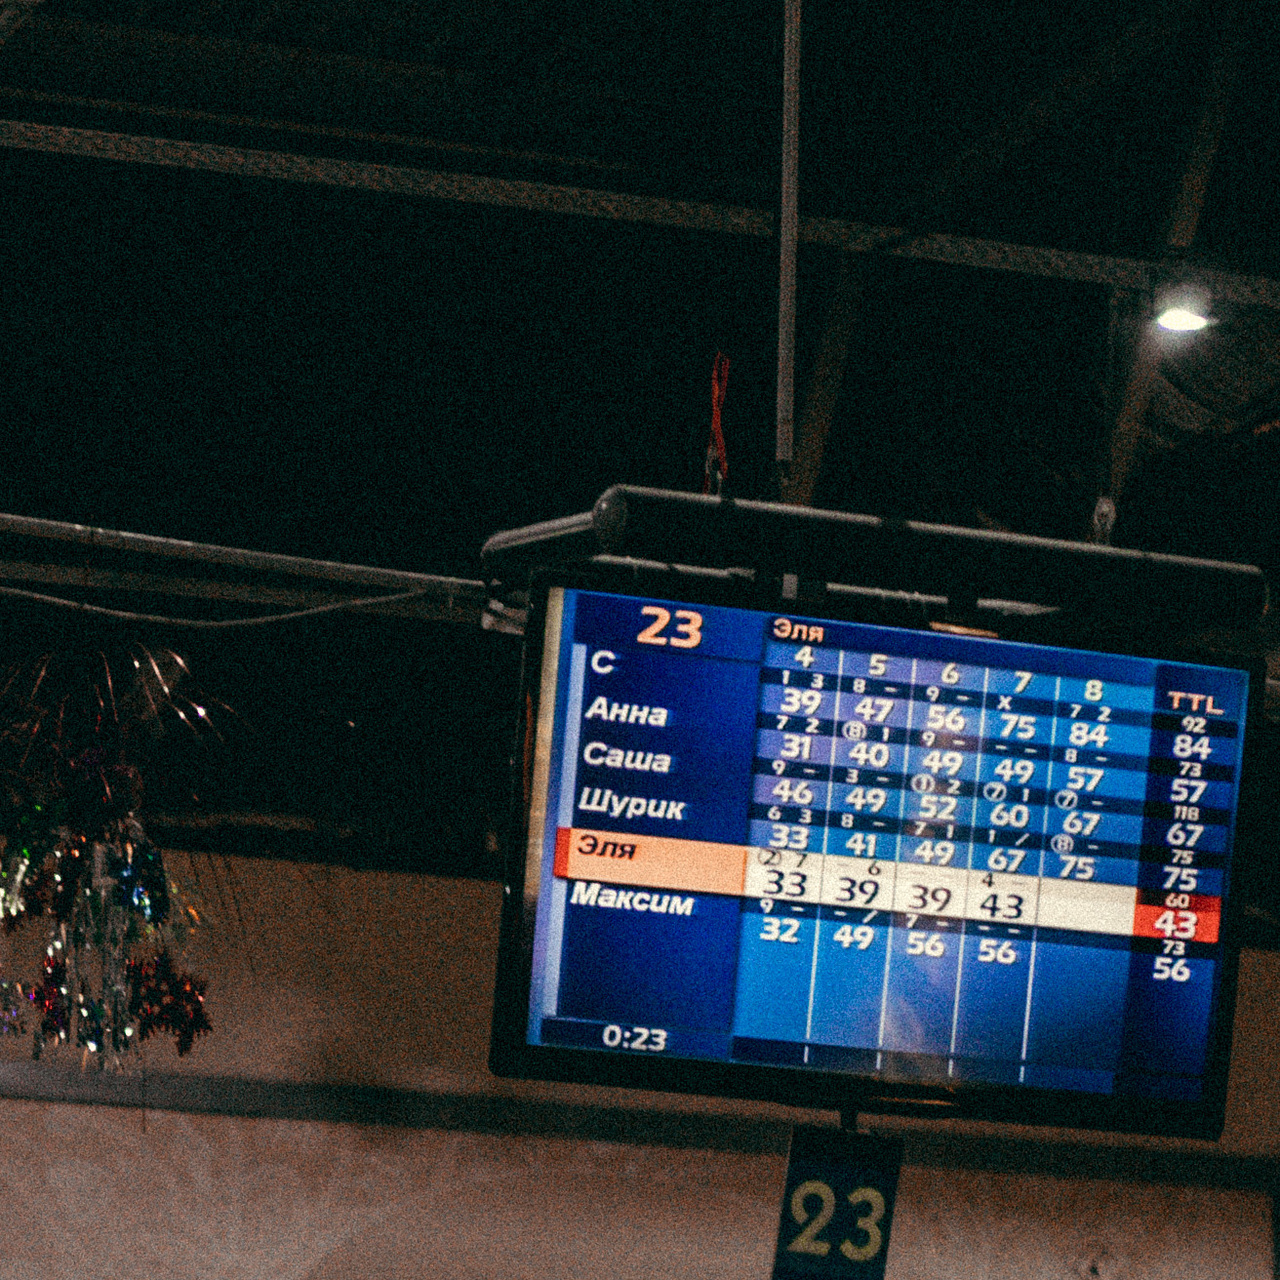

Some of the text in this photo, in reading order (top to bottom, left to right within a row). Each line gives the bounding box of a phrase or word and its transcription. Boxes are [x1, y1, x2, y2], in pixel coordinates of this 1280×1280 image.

[636, 605, 703, 649] 23
[773, 617, 825, 643] Эля
[794, 645, 1225, 716] 4 5 6 7 8 TTL
[584, 696, 1202, 778] Анна 73
[780, 687, 1213, 761] 39 47 56 75 84 84
[1182, 715, 1207, 734] 92
[583, 741, 672, 774] Саша
[781, 733, 1208, 804] 31 40 49 49 57 57
[578, 787, 686, 820] Шурик
[772, 779, 1204, 847] 46 49 52 60 67 67
[577, 834, 638, 861] Эля
[769, 824, 1199, 892] 33 41 49 67 75 75
[570, 881, 695, 916] Максим
[763, 869, 1198, 939] 33 39 39 43 43
[759, 917, 1191, 982] 32 49 56 56 56
[602, 1025, 668, 1051] 0:23
[786, 1180, 886, 1262] 23
